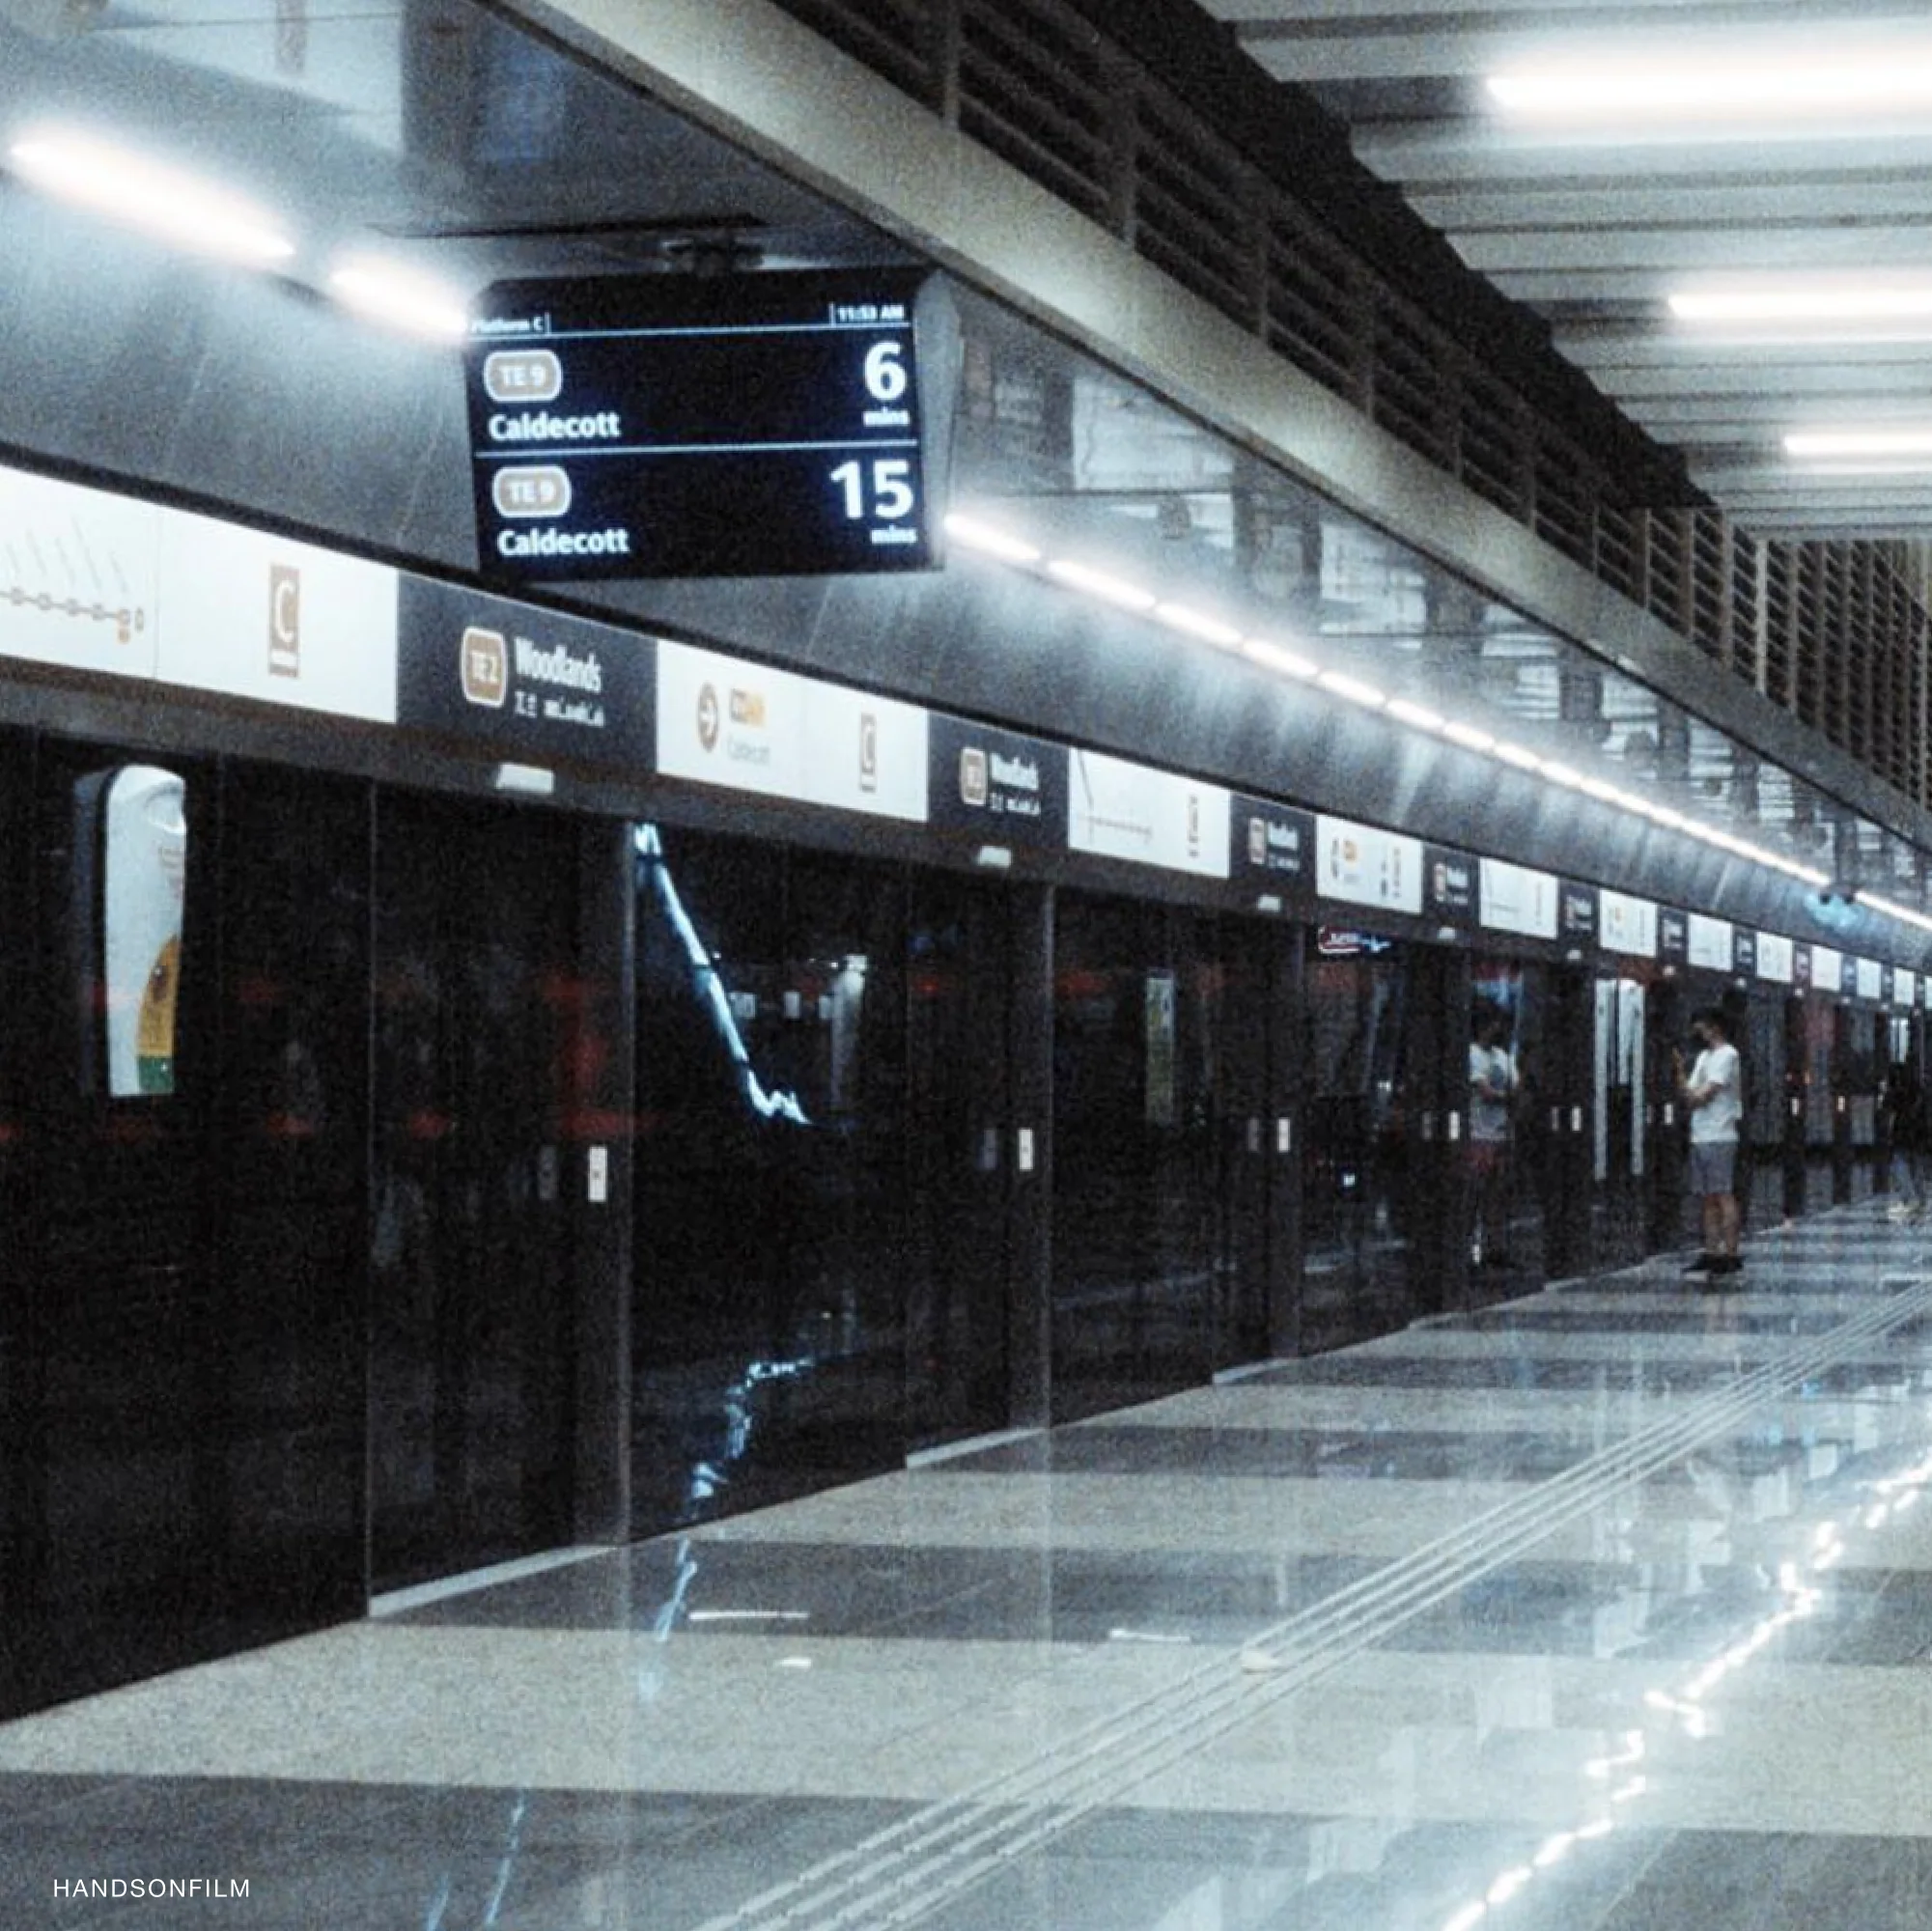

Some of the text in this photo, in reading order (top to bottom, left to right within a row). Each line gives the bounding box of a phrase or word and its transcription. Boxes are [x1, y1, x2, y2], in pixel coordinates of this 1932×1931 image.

[864, 341, 907, 401] 6
[488, 411, 623, 441] Caldecott
[830, 459, 914, 519] 15
[497, 527, 630, 556] Caldecott
[514, 635, 602, 694] Woodlands
